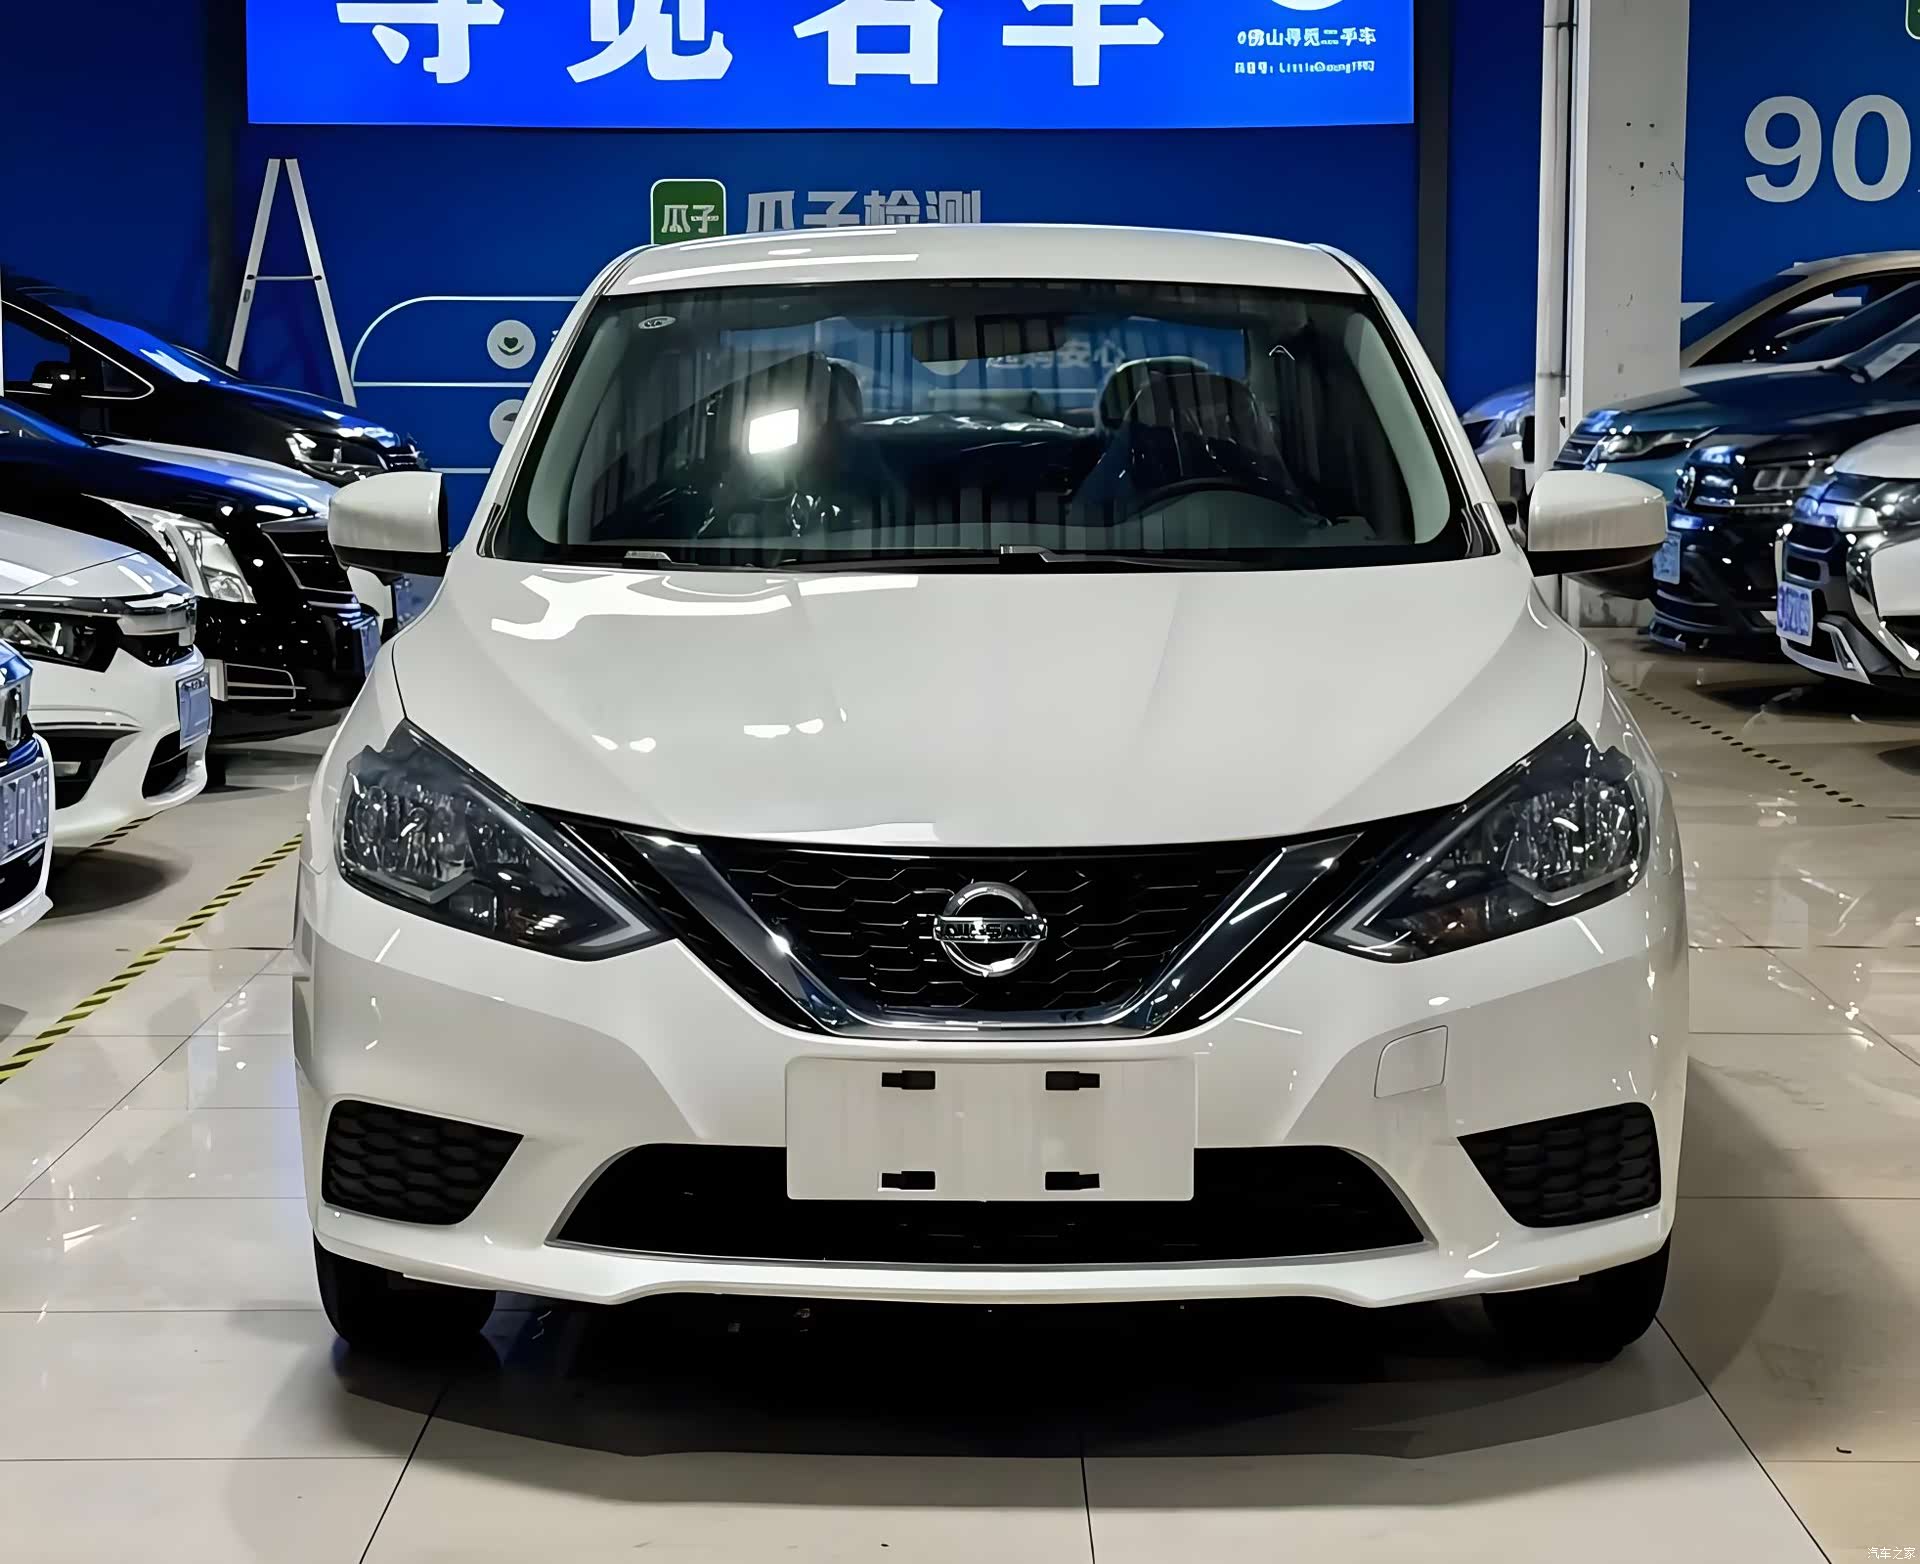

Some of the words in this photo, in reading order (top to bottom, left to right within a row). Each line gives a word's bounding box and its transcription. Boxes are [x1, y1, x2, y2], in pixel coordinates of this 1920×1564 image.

[661, 204, 720, 233] 瓜子
[746, 190, 982, 233] 瓜子检测
